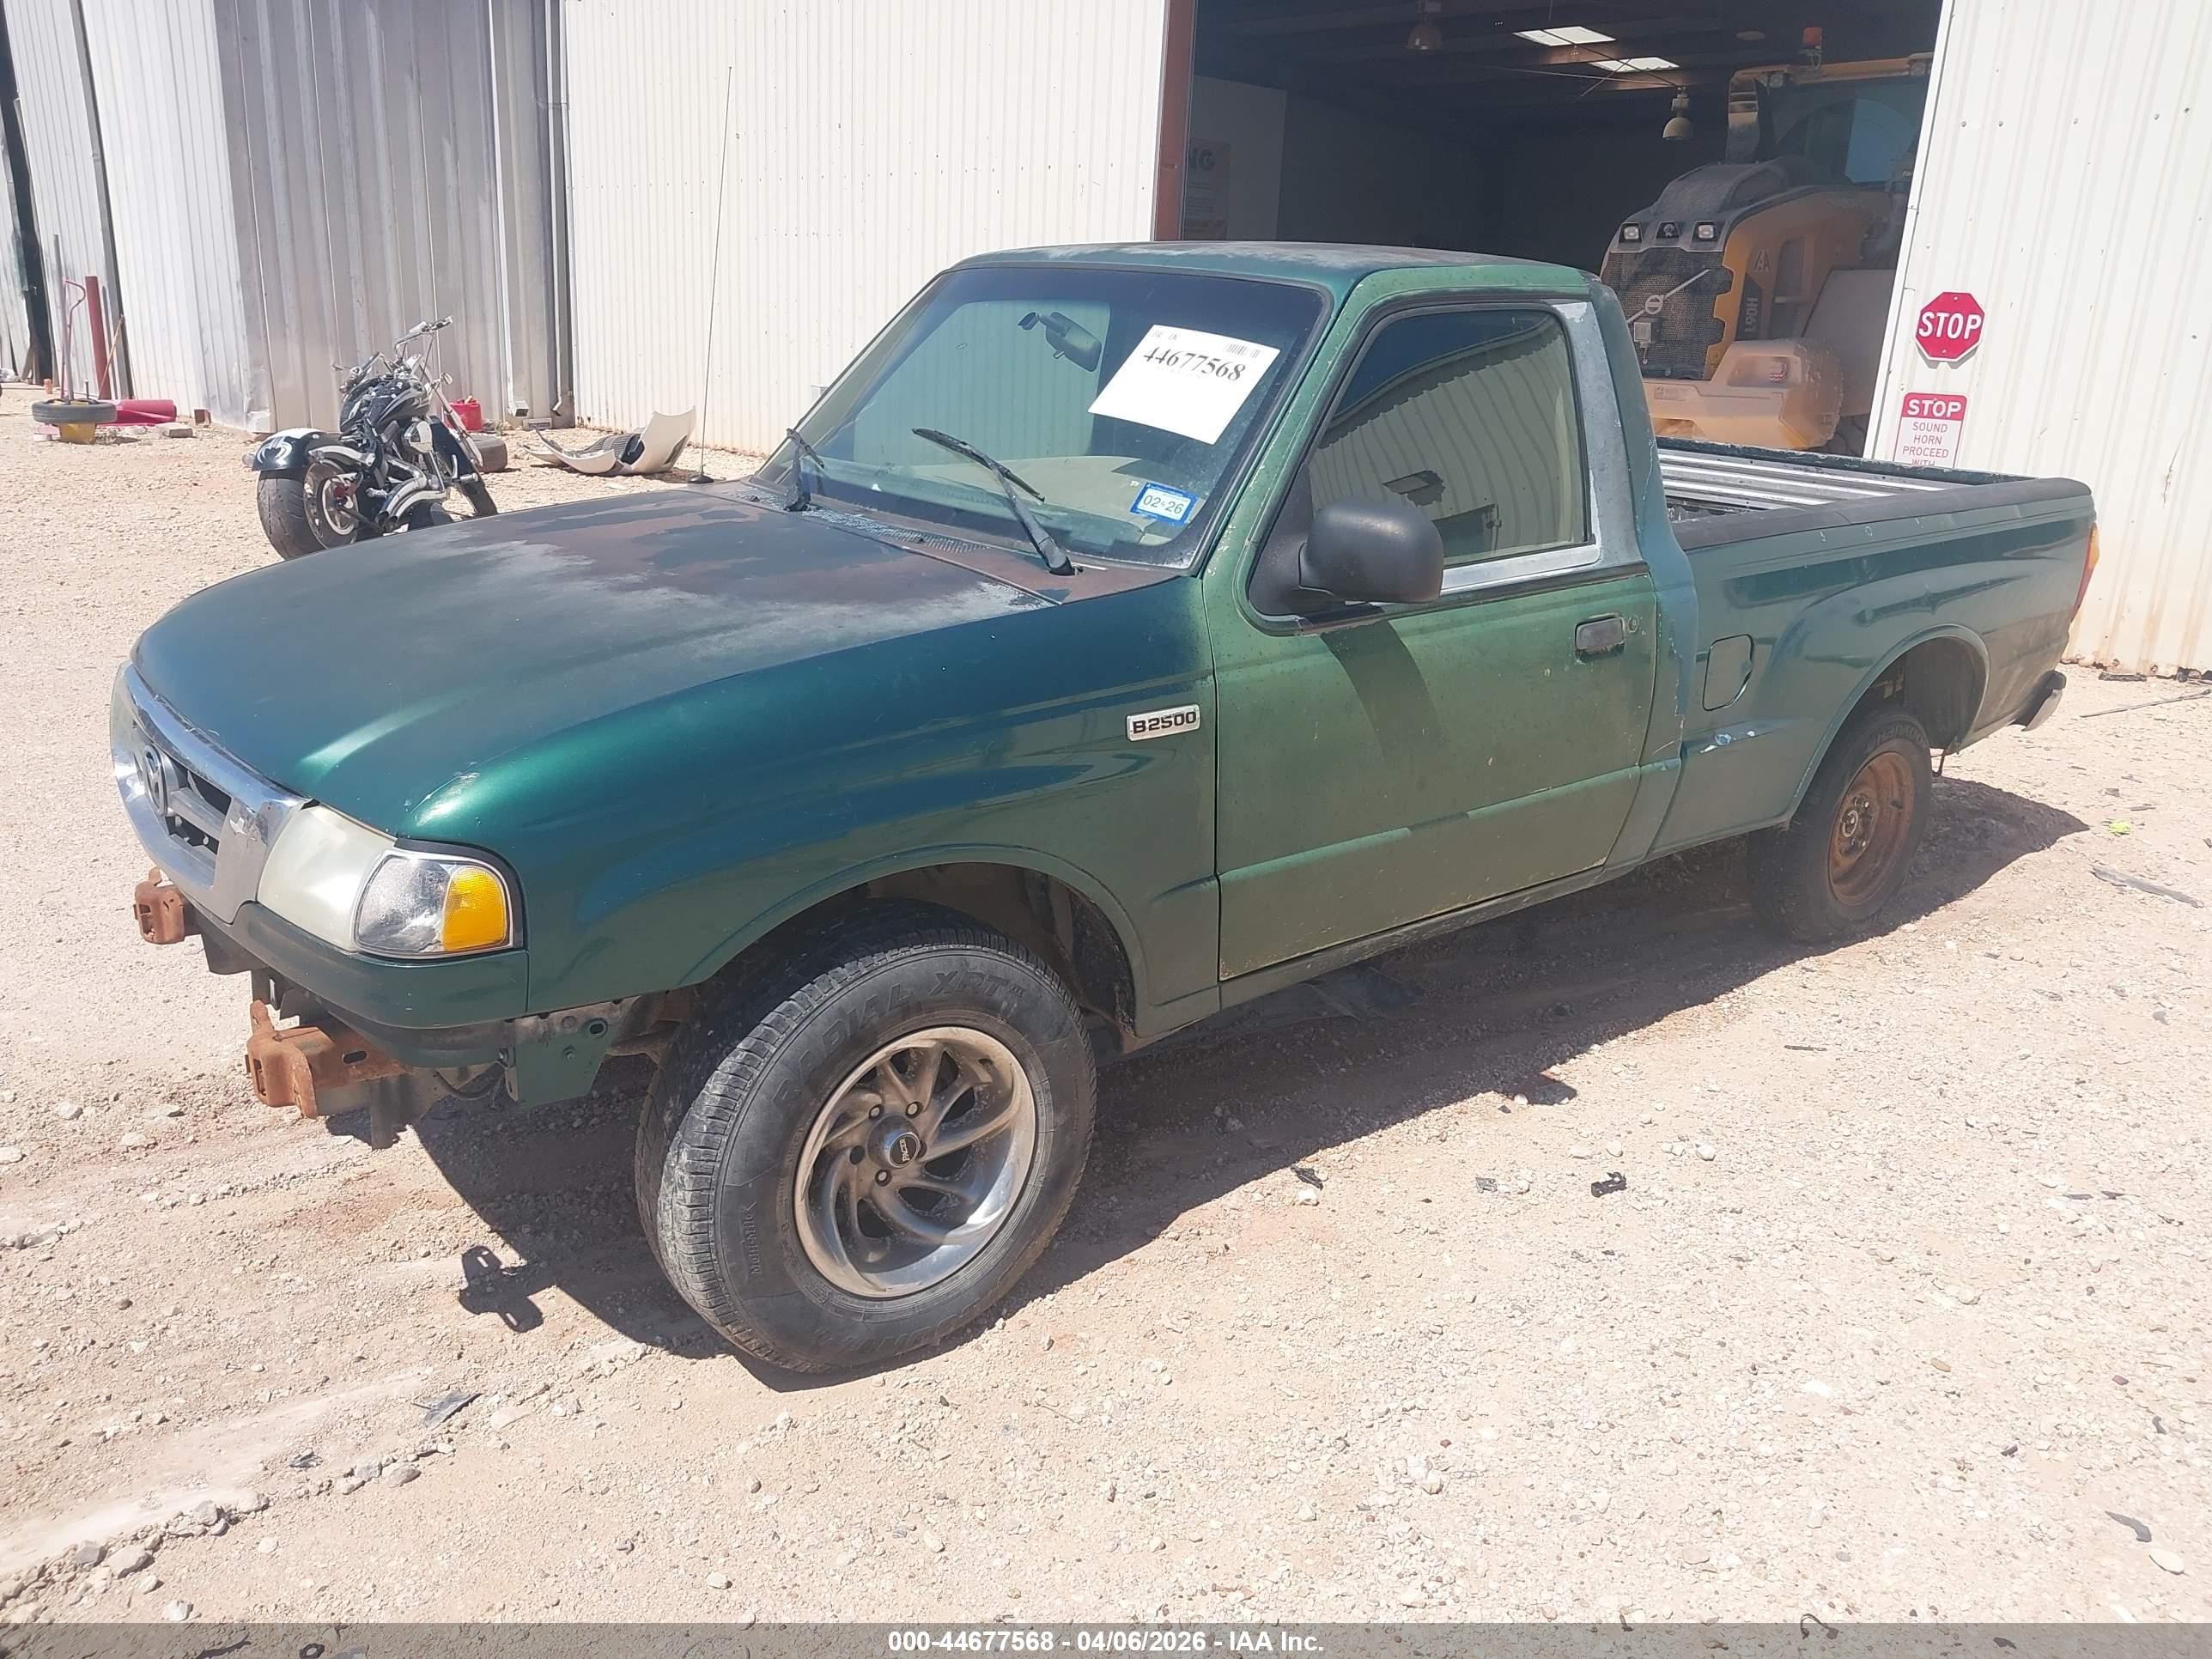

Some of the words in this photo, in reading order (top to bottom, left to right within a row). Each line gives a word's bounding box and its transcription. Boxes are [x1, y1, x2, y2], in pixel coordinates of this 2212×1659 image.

[1918, 311, 1982, 339] STOP
[1143, 346, 1246, 381] 44677568
[1906, 398, 1962, 418] STOP
[1912, 422, 1948, 433] SOUND
[1913, 434, 1942, 445] HORN
[1902, 446, 1949, 459] PROCEED
[1133, 711, 1197, 734] B2500
